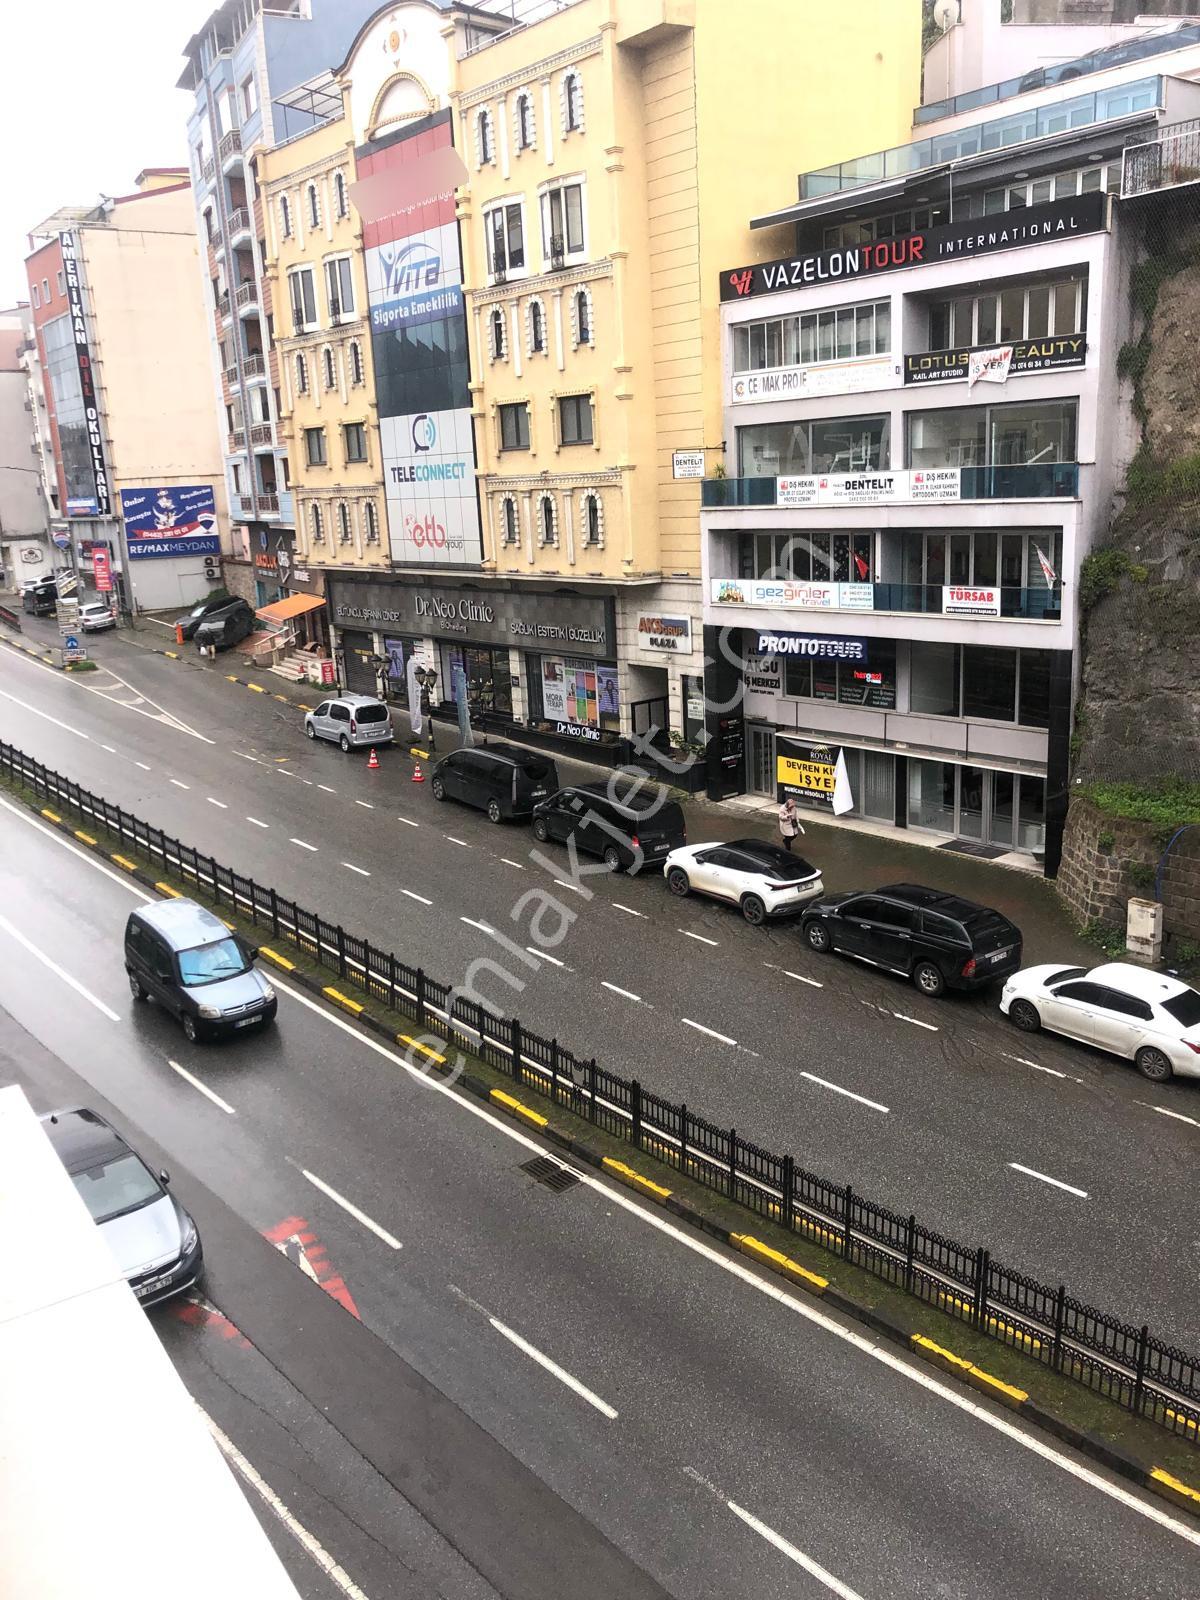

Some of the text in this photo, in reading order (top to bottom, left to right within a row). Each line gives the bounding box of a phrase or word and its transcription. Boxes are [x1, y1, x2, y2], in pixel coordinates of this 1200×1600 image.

[938, 216, 1079, 255] INTERNATIONAL
[373, 292, 459, 327] Sigorta Emeklilik
[908, 339, 1082, 371] LOTUS EAUTY
[912, 369, 963, 380] NAIL ART STUDIO
[391, 462, 466, 483] TELECONNECT
[756, 585, 830, 601] gezginler
[949, 587, 994, 602] TÜRSAB
[801, 598, 831, 607] travel
[458, 599, 494, 623] Clinic
[581, 726, 600, 741] Clinic
[810, 751, 833, 762] ROYAL
[786, 761, 820, 774] DEVREN
[822, 766, 835, 776] Kİ
